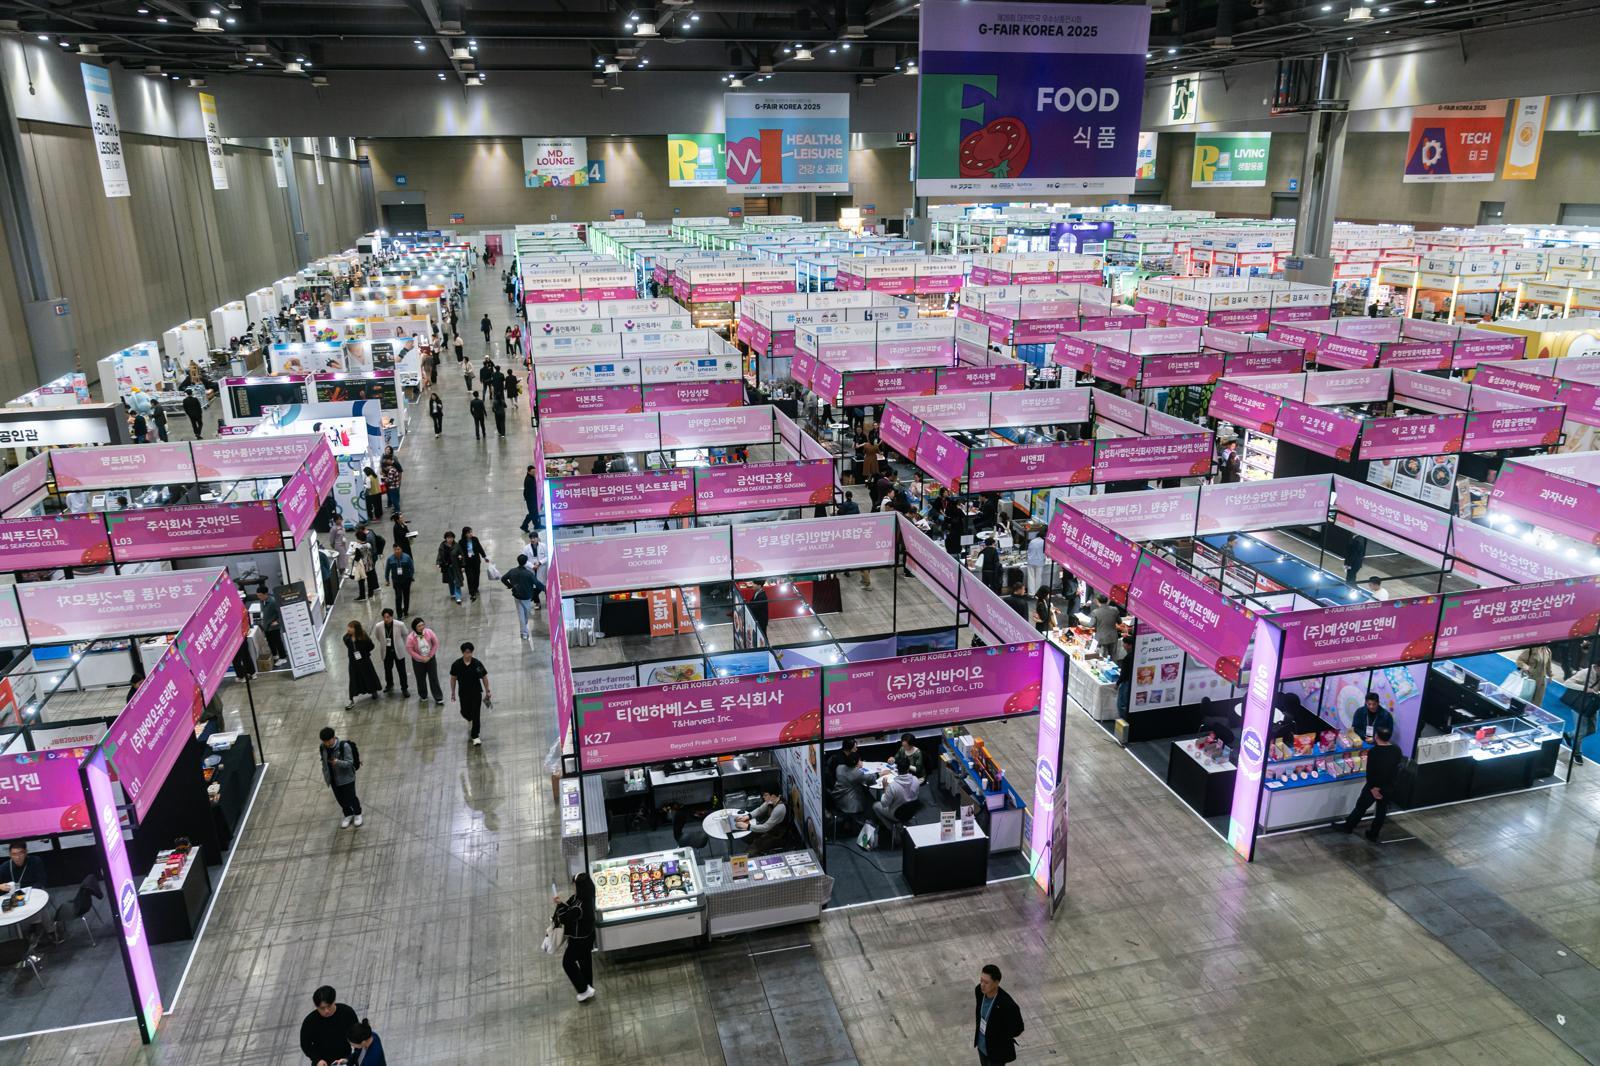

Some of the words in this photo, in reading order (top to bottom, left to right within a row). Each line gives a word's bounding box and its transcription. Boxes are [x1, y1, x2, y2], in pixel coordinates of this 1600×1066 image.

[978, 23, 1020, 36] G-FAIR
[1022, 24, 1064, 36] KOREA
[1067, 25, 1098, 37] 2025
[1036, 87, 1120, 112] FOOD
[786, 134, 842, 145] HEALTH&
[1460, 132, 1491, 144] TECH
[793, 148, 843, 160] LEISURE
[1234, 149, 1265, 158] LIVING
[536, 157, 575, 166] LOUNGE
[588, 163, 601, 180] 4
[798, 164, 815, 175] 건강
[816, 164, 824, 174] &
[826, 164, 843, 175] 레저
[0, 429, 38, 443] 공인관
[737, 472, 793, 486] 금산대근홍삼
[1539, 490, 1578, 508] 과자나라
[147, 518, 192, 530] 주식회사
[196, 514, 242, 528] 굿마인드
[1060, 520, 1078, 537] 적송원
[0, 528, 58, 542] 씨푸드(주)
[114, 537, 133, 546] L03
[11, 541, 41, 549] SEAFOOD
[1130, 587, 1142, 598] J27
[1158, 580, 1220, 628] (주)예성에프앤비
[1163, 600, 1179, 615] YESUNG
[1472, 602, 1506, 618] 삼다원
[1510, 593, 1576, 612] 장만순산삼가
[1492, 614, 1526, 624] SAMDAWON
[1303, 616, 1397, 640] (주)예성에프앤비
[1440, 626, 1458, 637] J01
[1314, 639, 1340, 647] YESUNG
[902, 655, 926, 664] G-FAIR
[928, 653, 952, 662] KOREA
[588, 674, 635, 686] self-farmed
[600, 681, 631, 691] oysters
[662, 682, 689, 692] G-FAIR
[690, 680, 718, 689] KOREA
[719, 677, 740, 686] 2025
[886, 666, 984, 692] (주)경신바이오
[887, 691, 916, 702] Gyeong
[969, 682, 984, 690] LTD
[616, 698, 716, 722] 티앤하베스트
[720, 690, 785, 711] 주식회사
[828, 701, 852, 714] K01
[130, 680, 177, 754] (주)바이오뉴트리젠
[672, 717, 715, 728] T&Harvest
[717, 714, 733, 722] Inc.
[584, 732, 611, 745] K27
[0, 773, 41, 792] 리젠
[129, 778, 142, 797] L01
